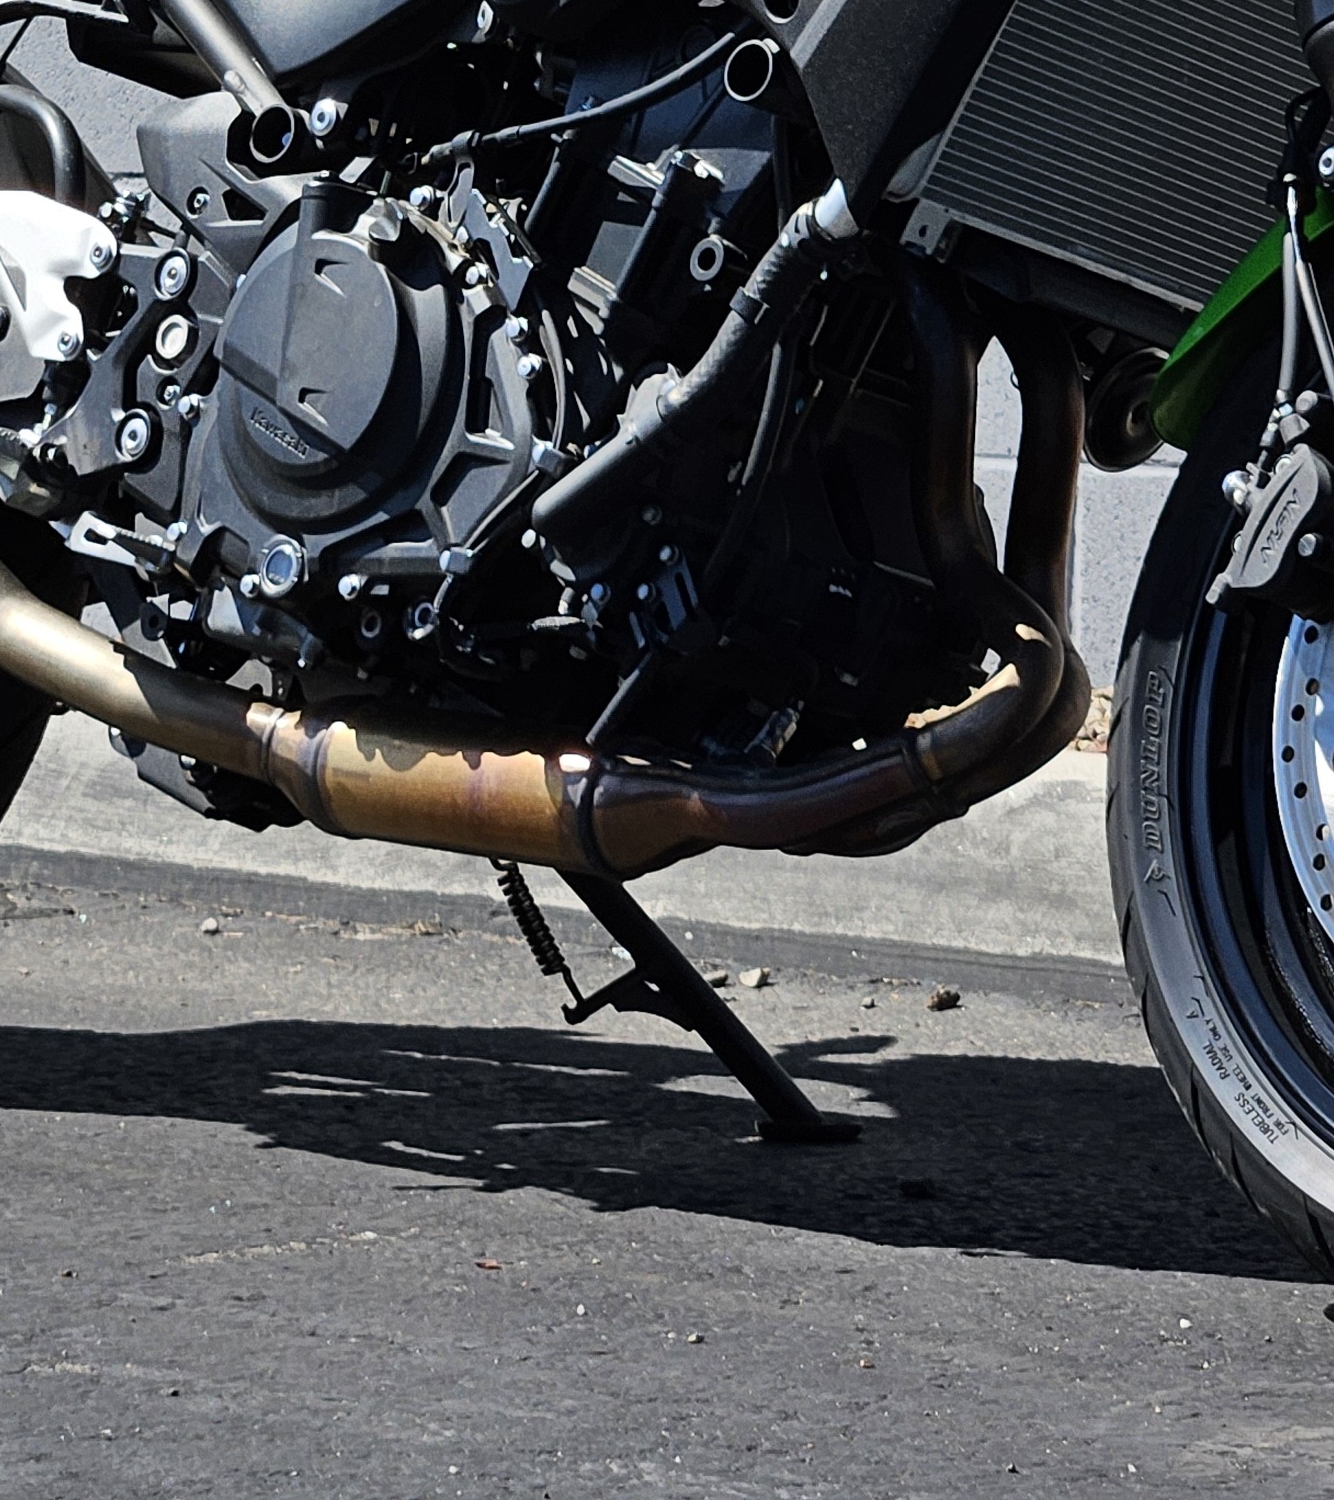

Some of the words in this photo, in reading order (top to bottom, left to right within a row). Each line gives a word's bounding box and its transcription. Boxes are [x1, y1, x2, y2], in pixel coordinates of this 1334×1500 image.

[250, 407, 309, 459] Kawasaki
[1260, 488, 1301, 565] NISSIN
[1140, 670, 1165, 852] DUNLOP
[1205, 1018, 1221, 1041] ONLY
[1202, 1039, 1230, 1080] RADIAL
[1218, 1043, 1233, 1062] USE
[1232, 1063, 1252, 1090] WHEEL
[1234, 1092, 1279, 1145] TUBELESS
[1250, 1092, 1274, 1118] FRONT
[1272, 1118, 1289, 1135] FOR
